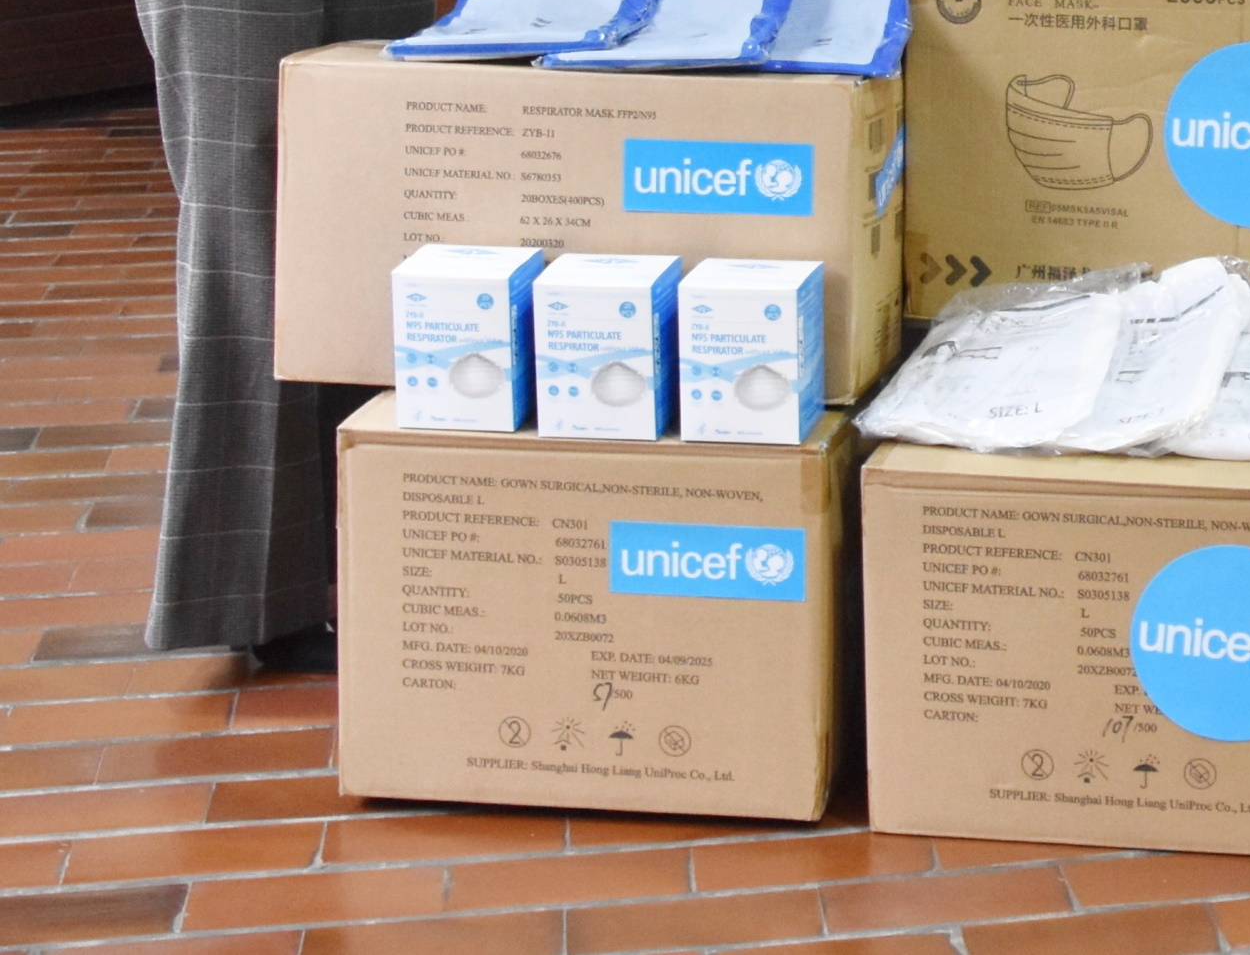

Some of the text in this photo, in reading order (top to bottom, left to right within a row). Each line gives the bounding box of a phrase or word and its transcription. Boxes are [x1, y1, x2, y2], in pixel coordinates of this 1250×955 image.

[1008, 13, 1149, 32] 一次性医用外科口罩
[406, 100, 452, 114] PRODUCT
[455, 103, 488, 115] NAME:
[522, 104, 583, 119] RESPIRATOR
[584, 107, 615, 120] MASK
[406, 123, 452, 136] PRODUCT
[454, 125, 514, 138] REFERENCE:
[633, 158, 754, 199] unicef
[404, 188, 605, 209] QUANTITY: 20BOXES(400PCS)
[1077, 218, 1099, 227] TYPE
[406, 320, 480, 333] N95 PARTICULATE
[548, 329, 622, 341] N95 PARTICULATE
[406, 332, 457, 344] RESPIRATOR
[548, 341, 599, 352] RESPIRATOR
[692, 331, 767, 344] N95 PARTICULATE
[692, 344, 744, 355] RESPIRATOR
[989, 404, 1042, 419] SIZE: L
[403, 473, 457, 487] PRODUCT
[460, 476, 497, 487] NAME:
[501, 477, 537, 490] GOWN
[685, 487, 764, 502] NON-WOVEN,
[403, 491, 485, 505] DISPOSABLE L
[403, 529, 446, 541] UNICEF
[450, 531, 467, 542] PO
[555, 537, 607, 550] 68032761
[621, 541, 742, 581] unicef
[923, 544, 1112, 563] PRODUCT REFERENCE: CN301
[403, 585, 592, 605] QUANTITY: 50PCS
[923, 599, 1089, 618] SIZE: L
[403, 640, 713, 668] MFG. DATE: 04/10/2020 EXP. DATE: 04/09/2025
[924, 691, 1048, 710] CROSS WEIGHT: 7KG
[466, 756, 528, 770] SUPPLIER:
[531, 760, 578, 777] Shanghai
[581, 763, 608, 779] Hong
[611, 764, 641, 780] Liang
[645, 766, 686, 781] UniProc
[714, 770, 735, 782] Ltd.
